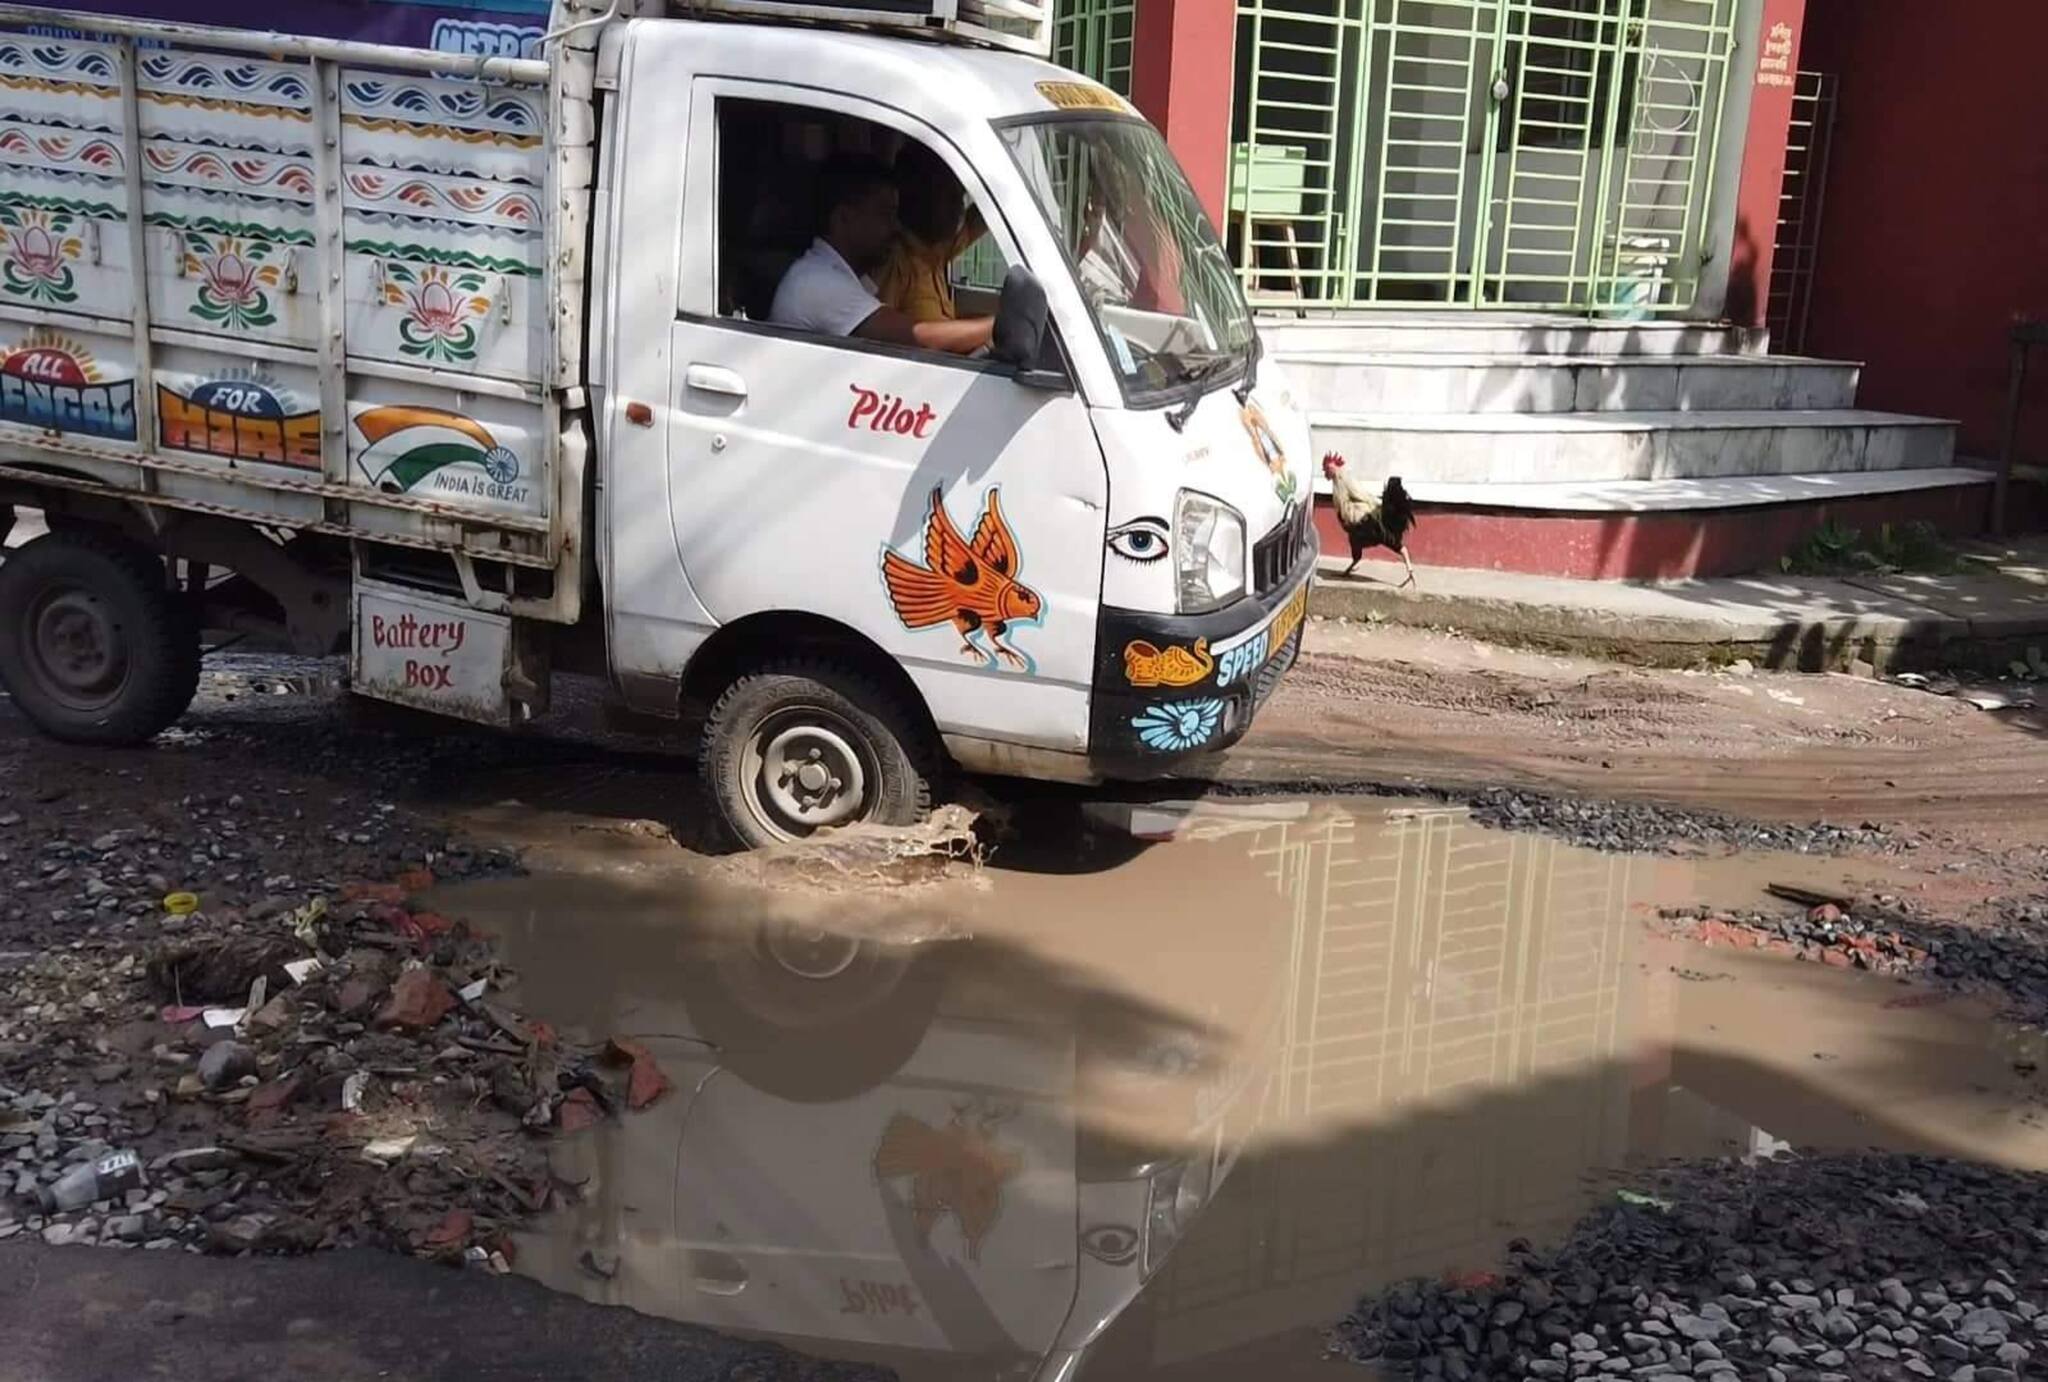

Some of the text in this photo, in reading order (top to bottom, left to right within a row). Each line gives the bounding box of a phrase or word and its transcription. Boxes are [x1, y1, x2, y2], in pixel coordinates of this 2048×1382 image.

[22, 353, 62, 379] ALL
[210, 387, 263, 414] FOR
[848, 383, 937, 438] Pilot
[157, 382, 322, 472] HIRE
[434, 472, 469, 494] INDIA
[487, 482, 528, 502] GREAT
[373, 613, 466, 656] Battery
[405, 660, 454, 690] Box
[1216, 629, 1269, 687] SPEED
